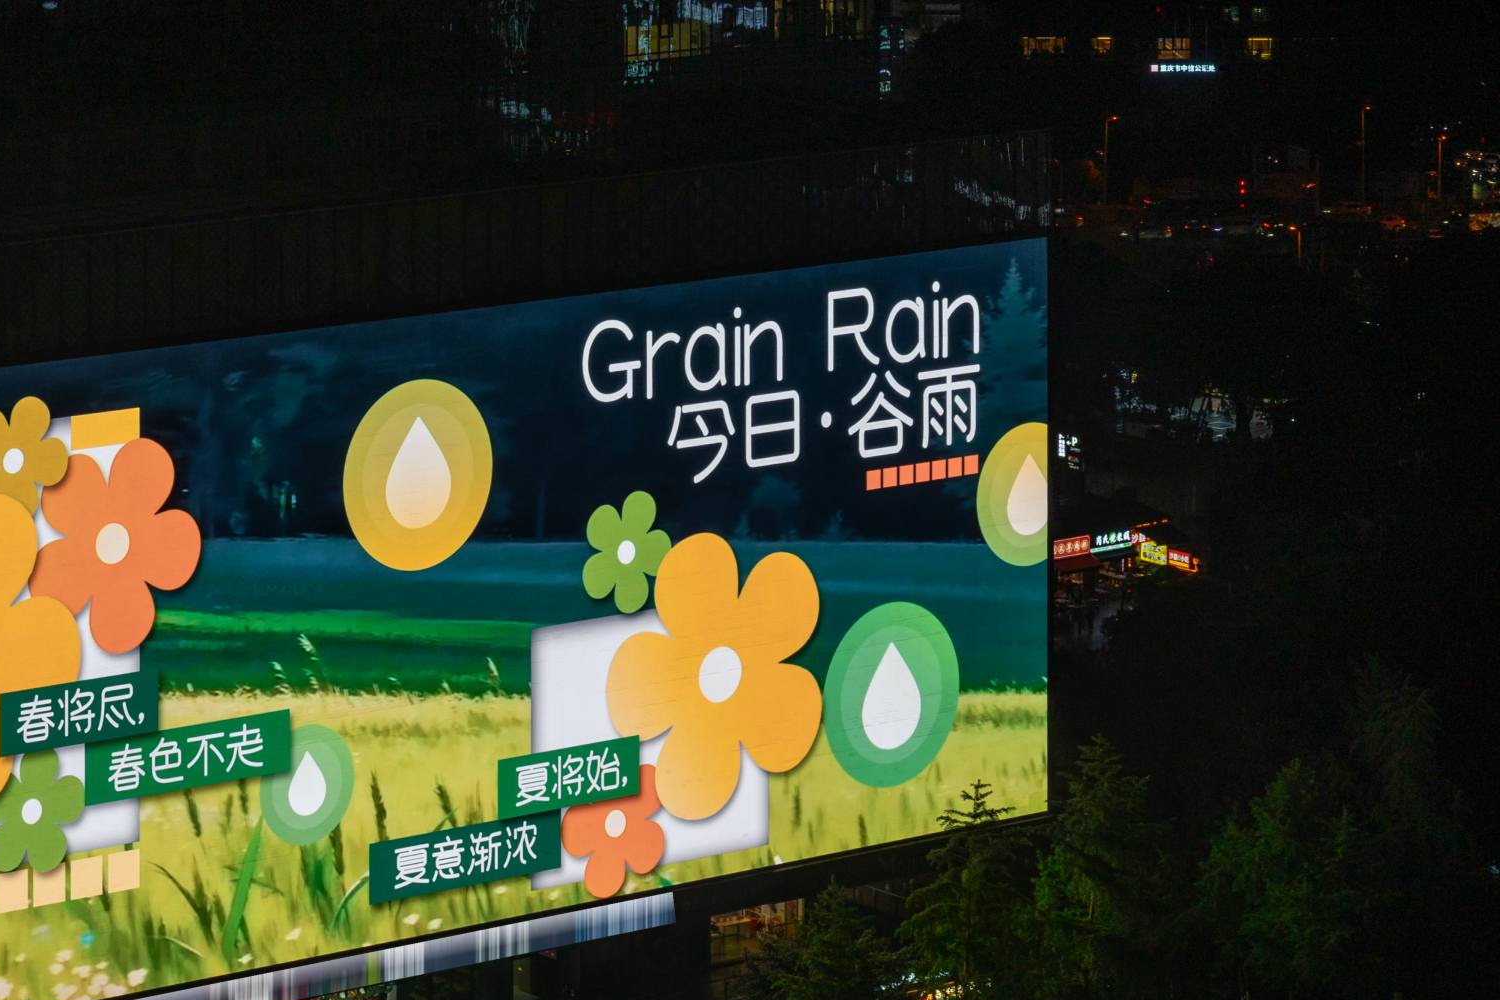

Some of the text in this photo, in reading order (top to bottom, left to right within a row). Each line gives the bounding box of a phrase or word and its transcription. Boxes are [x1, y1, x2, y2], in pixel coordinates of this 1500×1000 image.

[582, 280, 980, 403] Grain Rain
[666, 364, 980, 484] 今日·谷雨
[107, 721, 265, 792] 春色不老
[394, 820, 539, 891] 夏意渐浓
